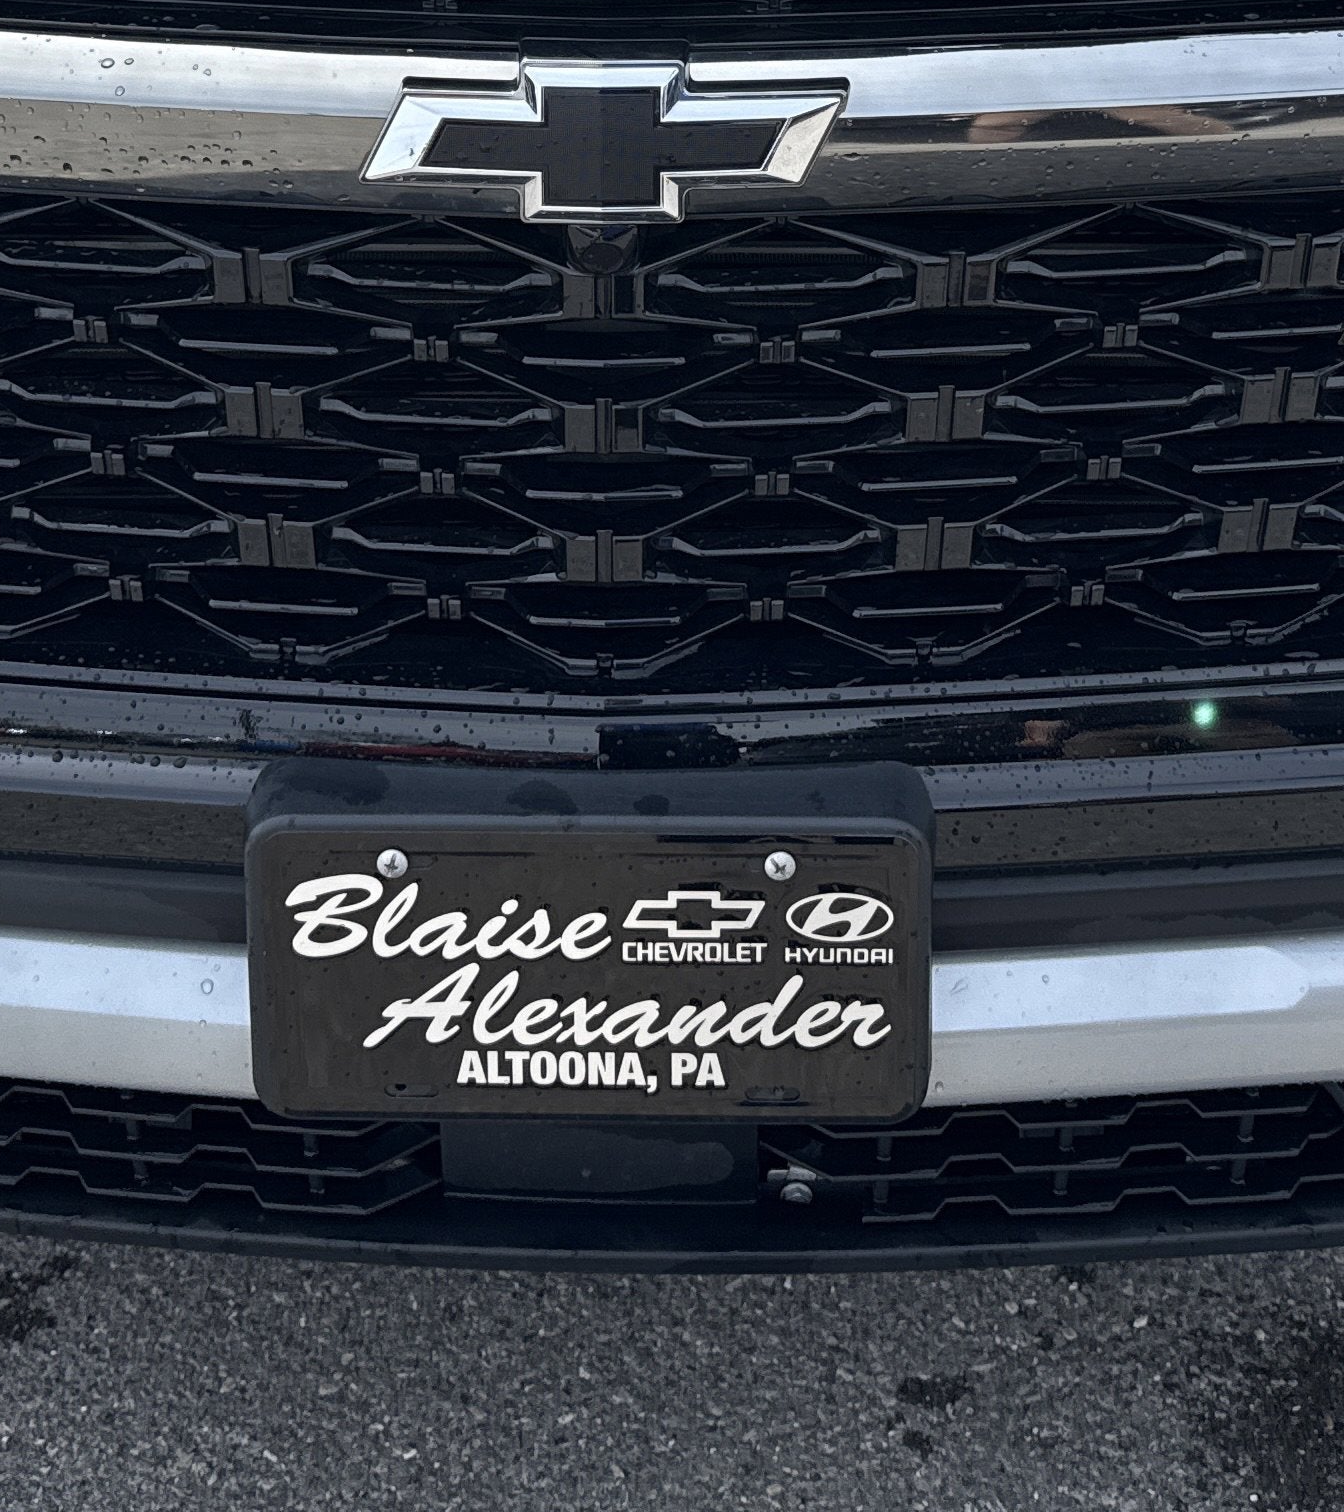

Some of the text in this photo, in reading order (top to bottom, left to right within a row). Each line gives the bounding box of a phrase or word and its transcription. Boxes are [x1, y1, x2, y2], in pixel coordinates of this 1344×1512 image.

[285, 873, 612, 960] Blaise
[622, 942, 767, 964] CHEVROLET
[784, 948, 894, 964] HYUNDAI
[363, 964, 891, 1050] Alexander
[457, 1050, 727, 1094] ALTOONA, PA
